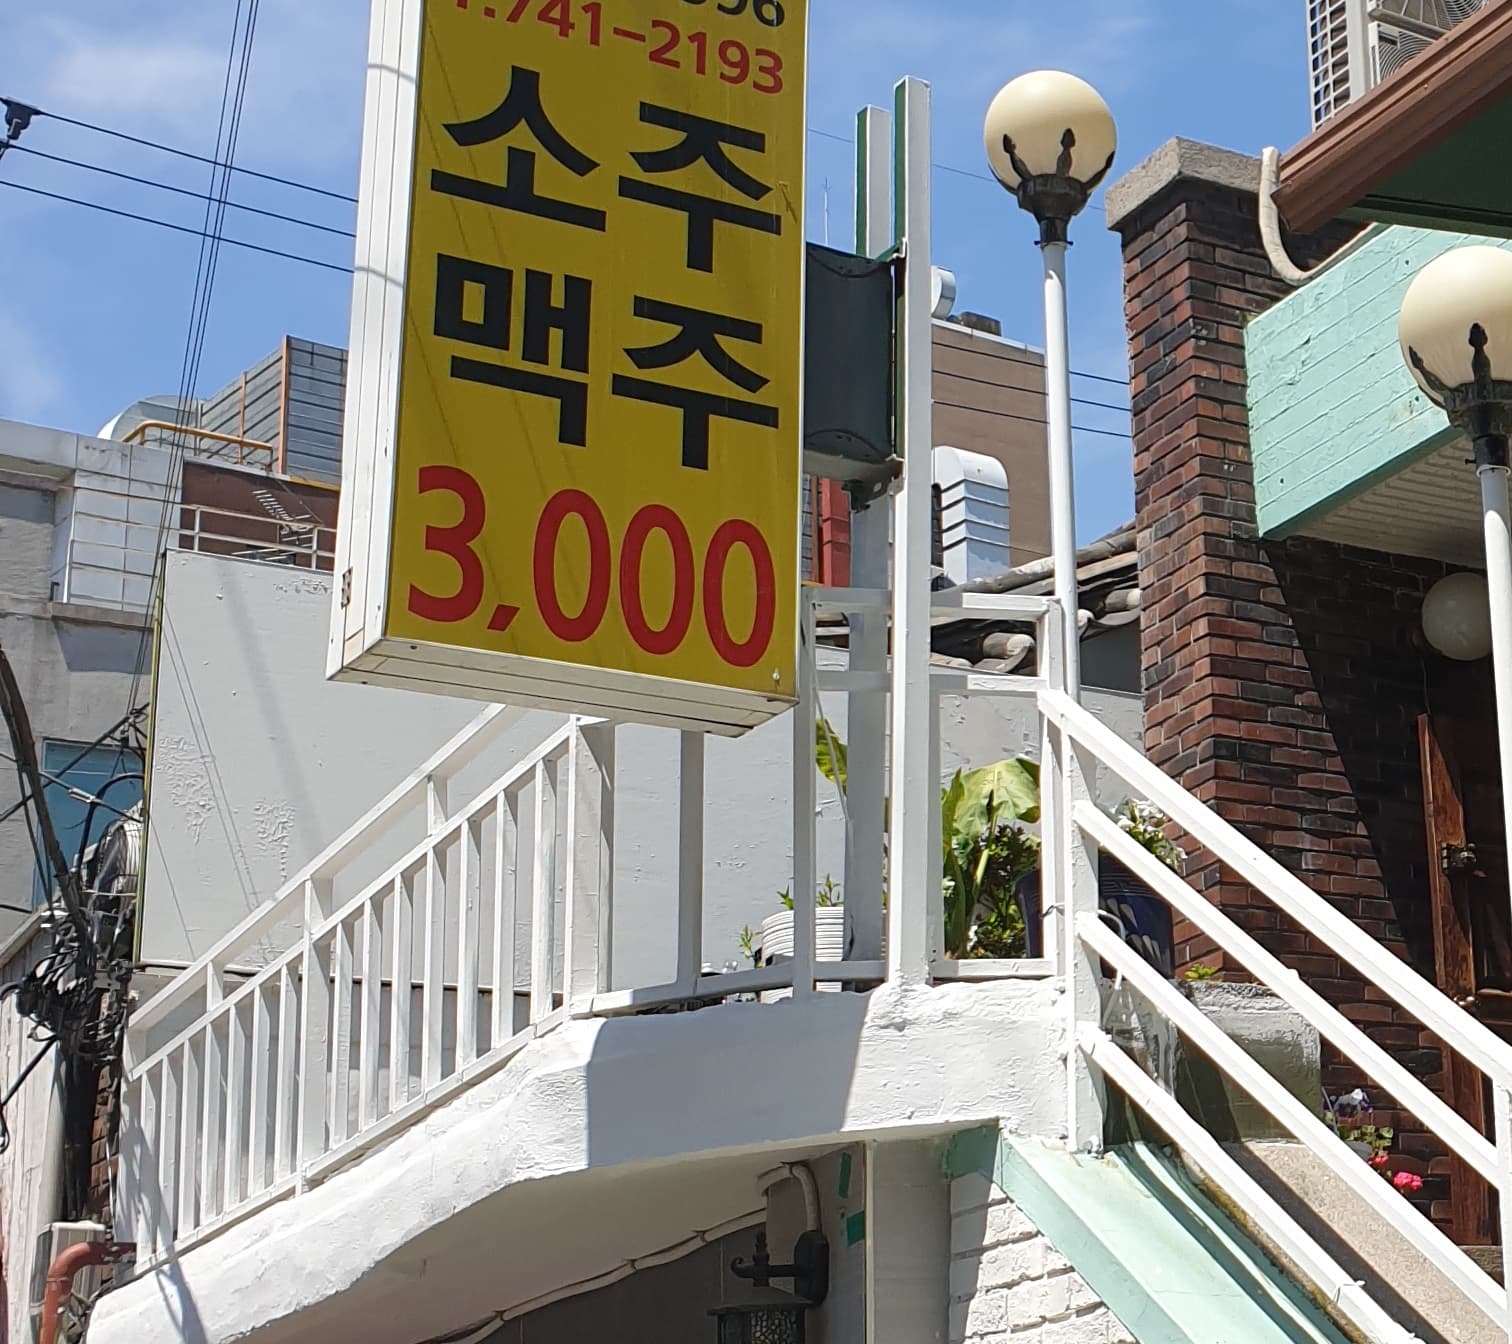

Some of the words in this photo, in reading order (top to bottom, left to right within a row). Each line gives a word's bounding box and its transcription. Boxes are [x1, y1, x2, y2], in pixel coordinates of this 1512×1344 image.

[430, 66, 782, 273] 소주
[433, 253, 779, 471] 맥주
[407, 466, 777, 668] 3,000
